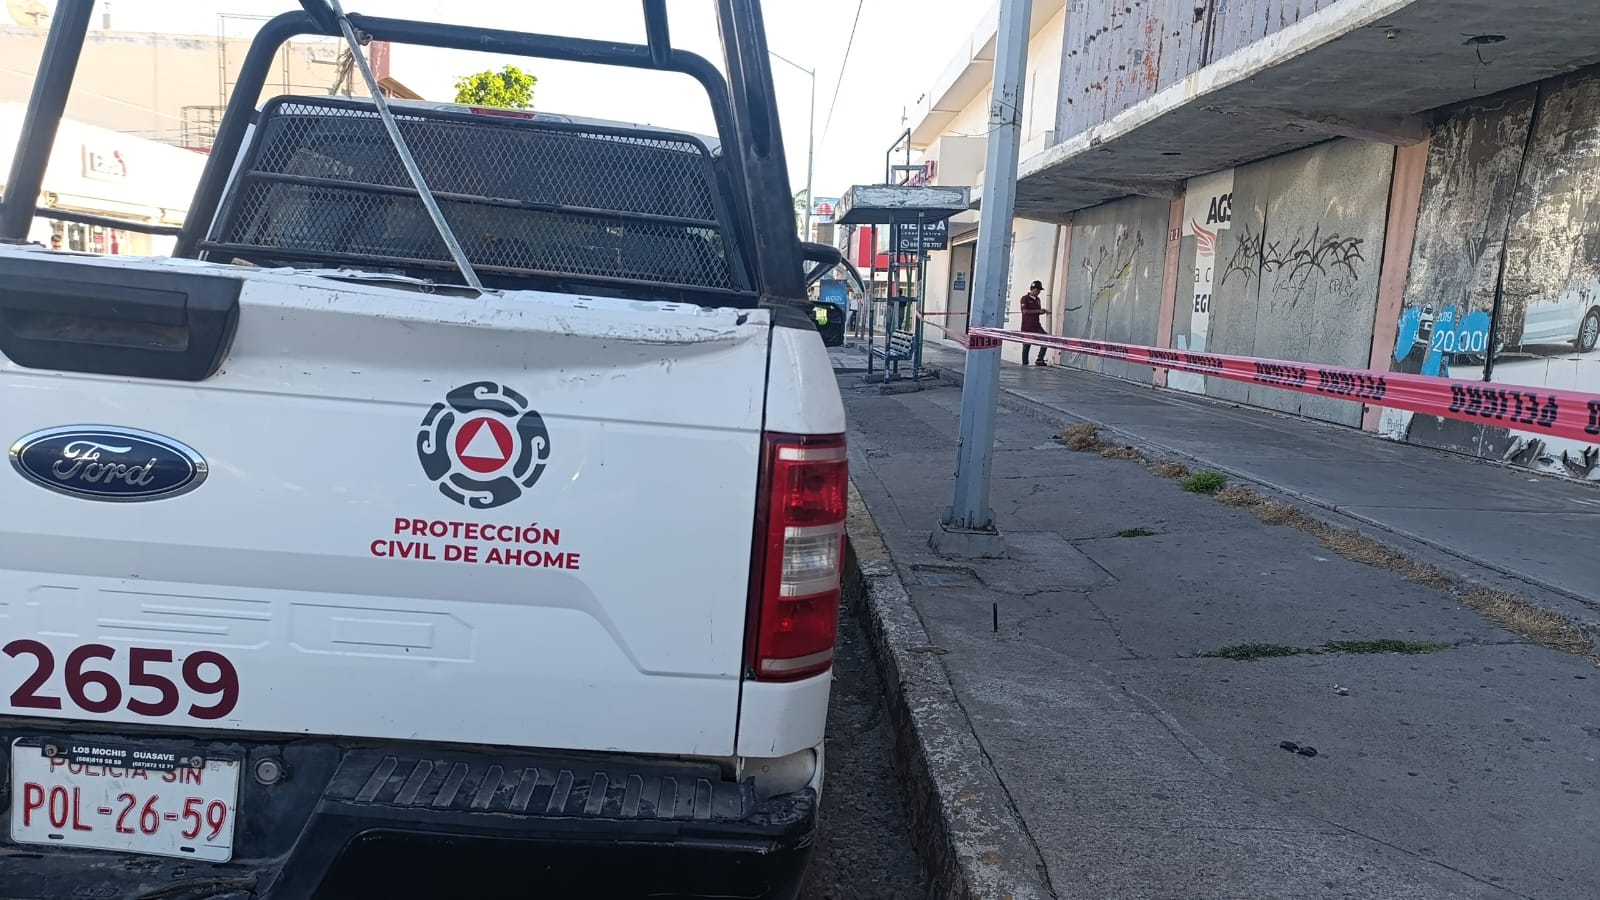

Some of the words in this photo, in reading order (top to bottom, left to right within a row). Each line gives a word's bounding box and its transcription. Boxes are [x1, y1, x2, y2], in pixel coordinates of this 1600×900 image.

[1448, 383, 1559, 428] PELIGRO
[52, 440, 157, 487] Ford
[394, 517, 560, 546] PROTECCIÓN
[370, 539, 436, 561] CIVIL
[444, 544, 478, 563] DE
[485, 547, 580, 570] AHOME
[1, 639, 239, 720] 2659
[72, 745, 90, 754] LOS
[91, 747, 127, 758] MOCHIS
[133, 751, 175, 761] GUASAVE
[23, 782, 227, 842] POL-26-59
